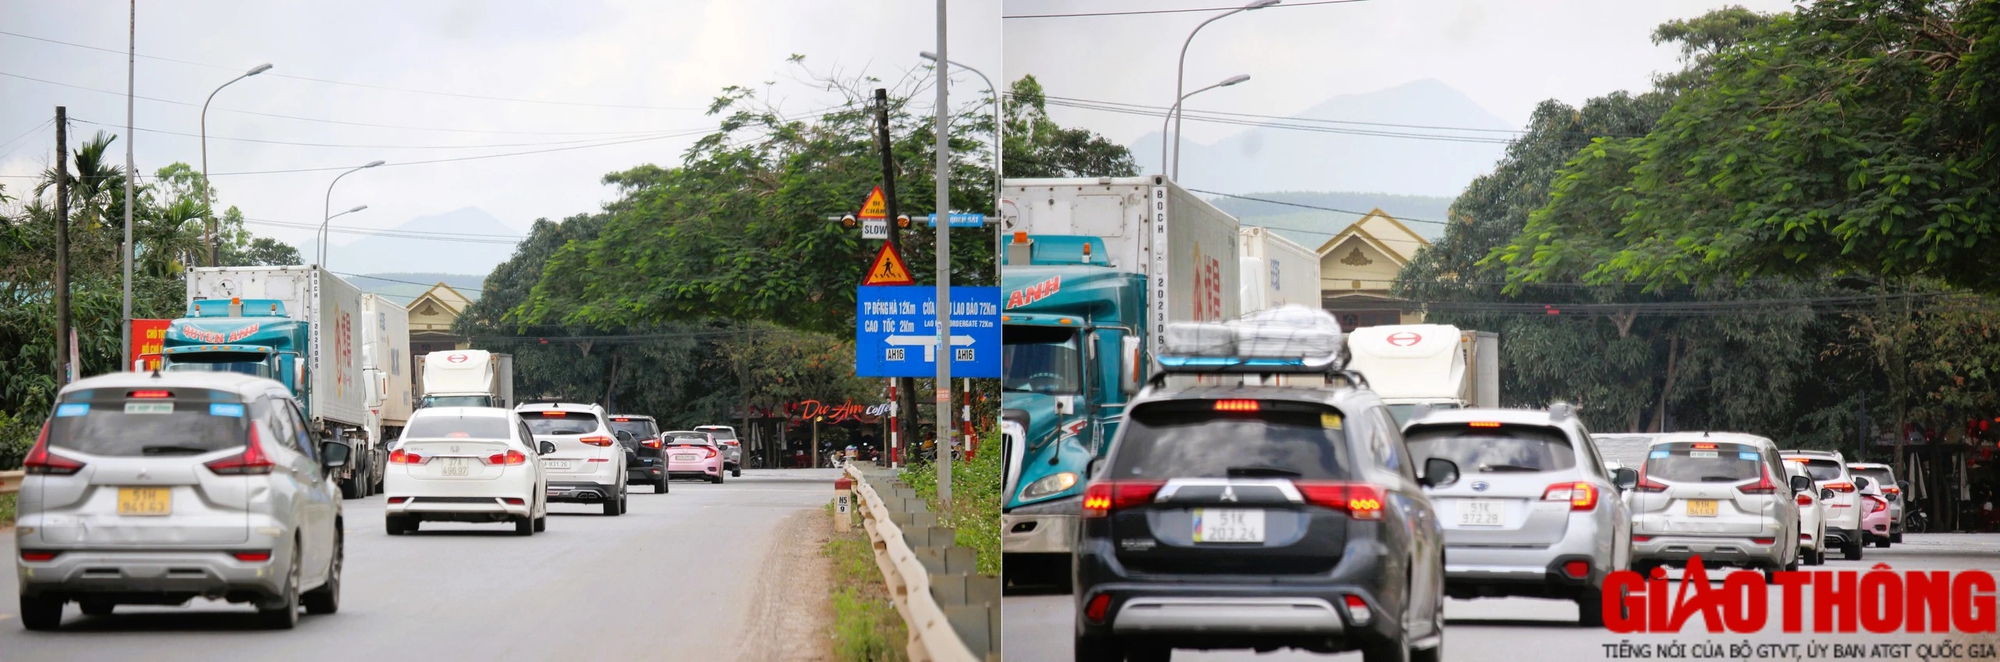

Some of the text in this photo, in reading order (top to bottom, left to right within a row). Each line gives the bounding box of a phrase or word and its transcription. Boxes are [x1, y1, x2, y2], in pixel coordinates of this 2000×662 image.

[864, 225, 888, 235] SLOW
[1006, 275, 1061, 309] ANH
[864, 302, 871, 315] TP
[889, 299, 897, 315] HÀ
[899, 301, 916, 315] 12Km
[953, 302, 964, 315] LAO
[965, 297, 978, 315] BẢO
[979, 302, 997, 315] 72Km
[865, 318, 915, 332] CAO TỐC 2Km
[228, 321, 260, 344] ANH
[887, 349, 904, 360] AH16
[957, 349, 973, 360] AH16
[866, 403, 893, 416] Coffe
[448, 458, 462, 466] 37A
[1470, 503, 1489, 513] 51K
[1219, 512, 1246, 526] 51K
